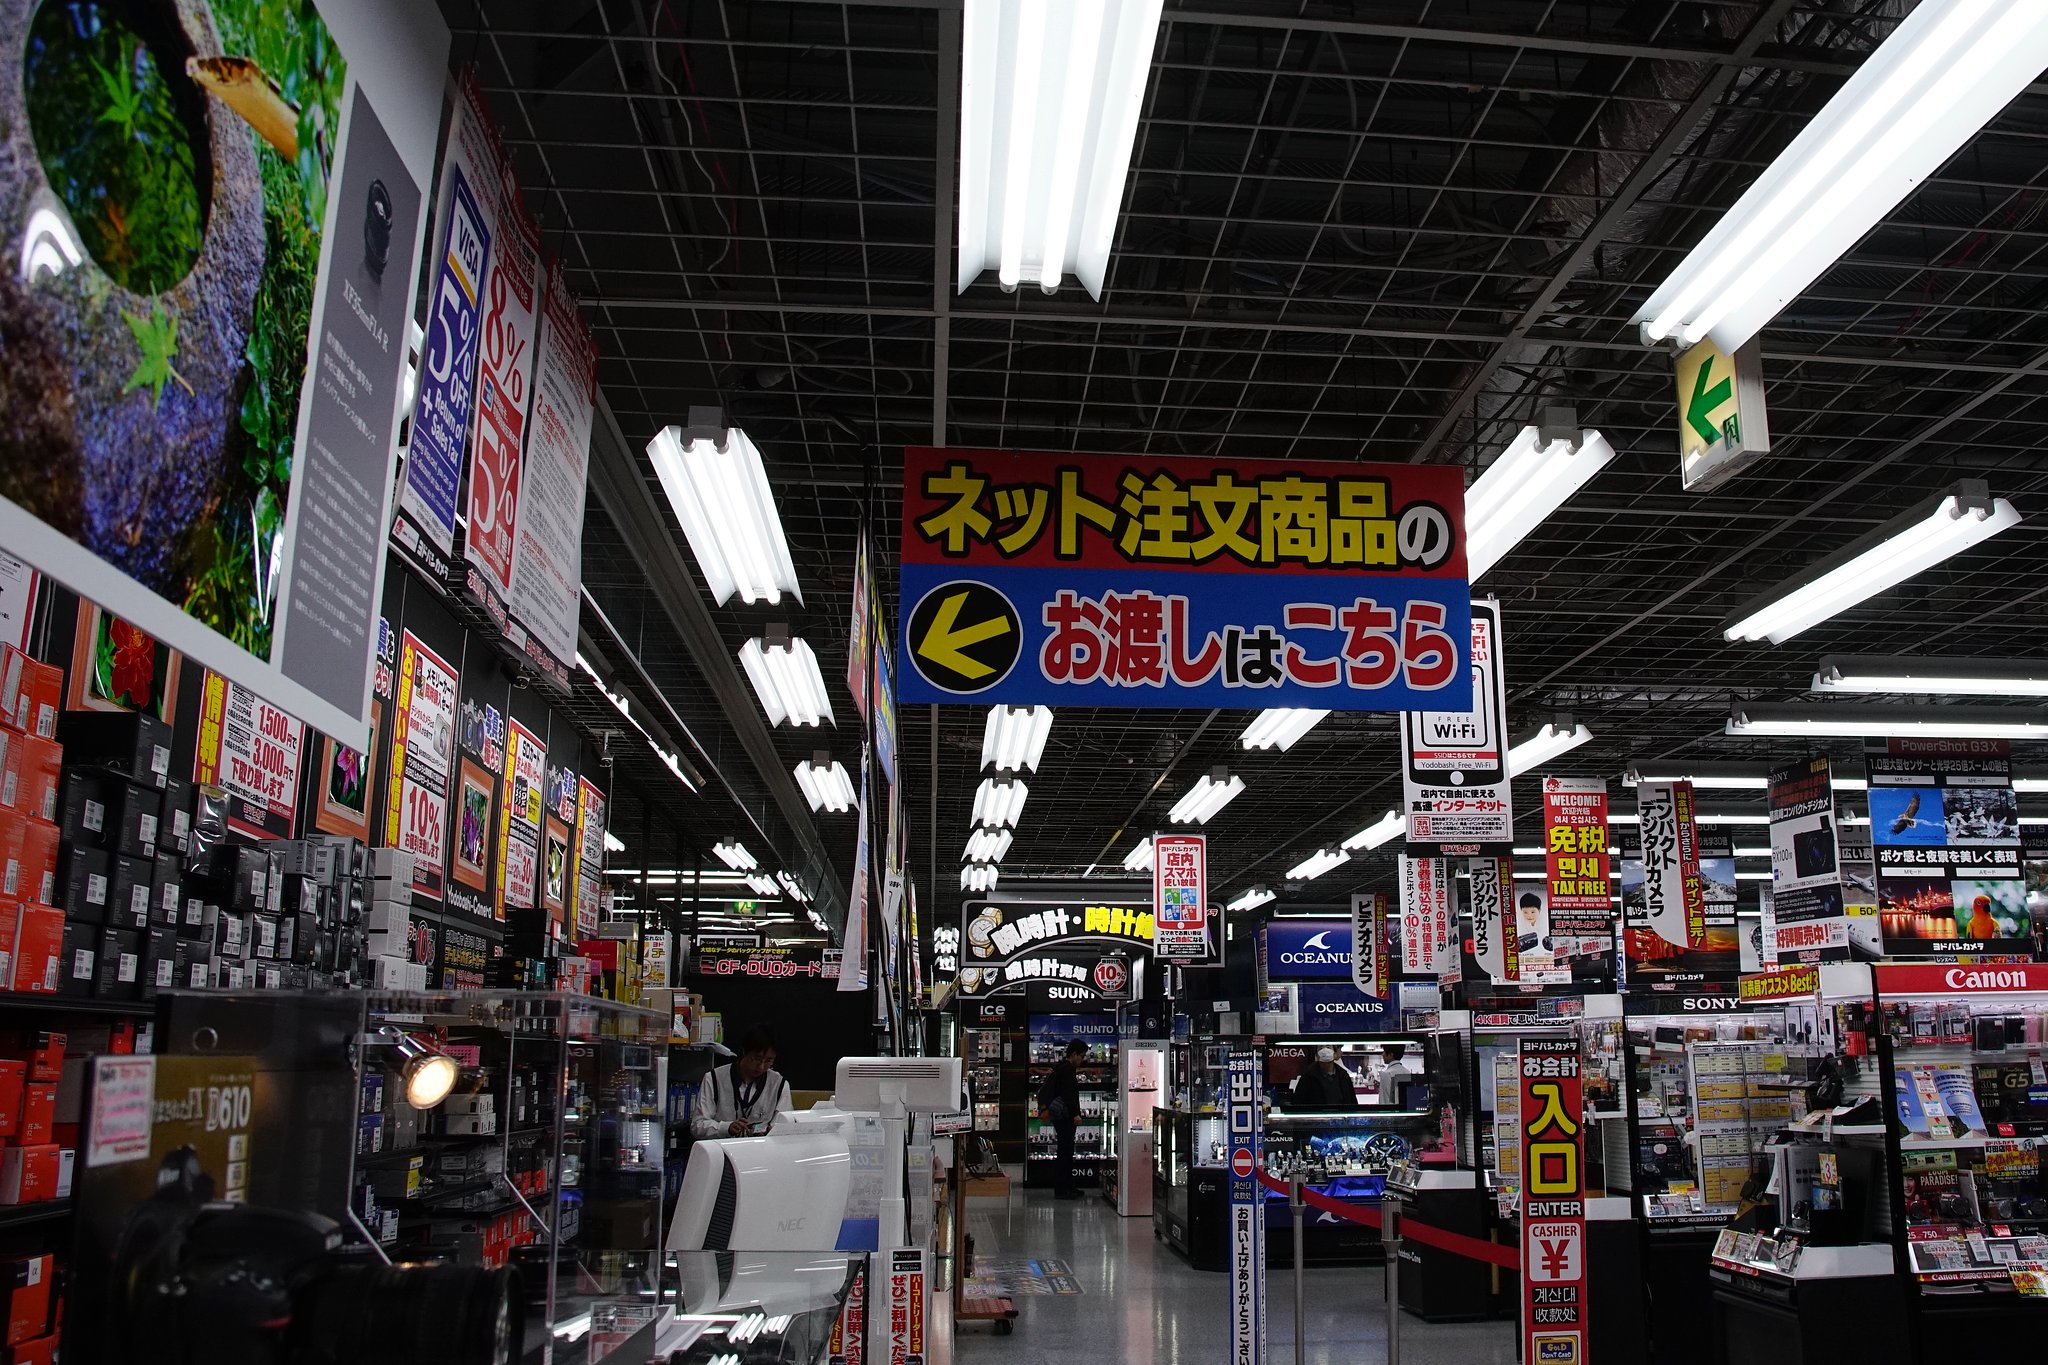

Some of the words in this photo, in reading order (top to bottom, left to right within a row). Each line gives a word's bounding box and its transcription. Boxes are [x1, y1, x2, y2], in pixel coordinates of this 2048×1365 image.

[457, 215, 478, 283] VISA
[428, 273, 475, 384] 5%
[486, 265, 526, 403] 8%
[450, 371, 469, 416] OFF
[435, 388, 455, 433] Return
[454, 421, 464, 443] of
[431, 412, 448, 454] Sales
[447, 438, 459, 467] Tax
[474, 412, 517, 535] 5%
[919, 462, 1453, 568] ネット注文商品の
[416, 537, 449, 582] ヨドバシカメラ
[1042, 588, 1458, 690] お渡しはこちら
[426, 667, 456, 695] メモリーカード
[259, 704, 298, 750] 1,500円で
[1901, 740, 1968, 752] PowerShot
[253, 737, 294, 782] 3,000円で
[1421, 761, 1492, 769] Yodobashi_Free_Wi-Fi
[1870, 758, 2009, 772] 1.0型大型センサーと光学25倍ズームの融合
[231, 756, 285, 801] 下取り致します
[1768, 771, 1789, 785] SONY
[1420, 789, 1496, 798] 店内で自由に使える
[1550, 795, 1601, 807] WELCOME!
[409, 786, 440, 844] 10%
[1411, 800, 1507, 812] 高速インターネット
[1554, 815, 1569, 824] 어서
[1570, 815, 1598, 824] 오십시오
[1655, 788, 1677, 869] コンパクト
[405, 832, 440, 860] お値引き致します
[1439, 844, 1481, 852] ヨドバシカメラ
[1549, 826, 1607, 854] 免税
[1166, 852, 1194, 866] 店内
[1640, 800, 1665, 918] デジタルカメラ
[1880, 849, 2017, 863] ボケ感と夜景を美しく表現
[1164, 867, 1197, 878] スマホ
[1557, 857, 1600, 879] 면세
[1164, 879, 1197, 887] 使い放題
[1484, 859, 1499, 920] コンパクト
[1551, 880, 1576, 895] TAX
[1578, 880, 1607, 895] FREE
[446, 883, 493, 919] Yodobashi-Camera
[1434, 858, 1447, 952] 当店は全ての商品が
[1404, 861, 1419, 969] さらにポイント10%還元中
[1417, 858, 1433, 970] 消費税込みの特価表示で
[1471, 868, 1489, 957] デジタルカメラ
[1555, 920, 1606, 928] ヨドバシカメラ
[1357, 900, 1373, 985] ビデオカメラ
[1932, 941, 1985, 951] ヨドバシカメラ
[716, 958, 822, 977] CF・DUOカード
[1004, 958, 1088, 982] 腕時計売場
[1097, 965, 1127, 981] 10%
[1664, 973, 1705, 981] ヨドバシカメラ
[1945, 968, 2027, 988] Canon
[1740, 975, 1790, 1001] 販売員オススメ
[1315, 1003, 1384, 1013] OCEANUS
[1682, 997, 1740, 1010] SONY
[1073, 1025, 1114, 1034] SUUNTO
[1523, 1042, 1578, 1051] ヨドバシカメラ
[1228, 1060, 1254, 1071] お会計
[1523, 1056, 1579, 1077] お会計
[205, 1085, 252, 1132] D610
[1231, 1073, 1253, 1133] 出口
[1234, 1136, 1251, 1144] EXIT
[1527, 1083, 1578, 1195] 入口
[1233, 1181, 1252, 1190] 계산대
[1528, 1201, 1582, 1217] ENTER
[777, 1217, 807, 1233] NEC
[1532, 1225, 1577, 1237] CASHIER
[1539, 1239, 1571, 1279] ¥
[1931, 1273, 1959, 1281] Canon
[1534, 1287, 1577, 1303] 계산대
[892, 1274, 907, 1365] ぜひご利用くださ
[911, 1275, 921, 1352] バーコードリーダーつき
[1535, 1307, 1577, 1323] 收款处
[1541, 1350, 1558, 1359] POINT
[1557, 1350, 1572, 1359] CARD
[1546, 1343, 1567, 1351] GOLD
